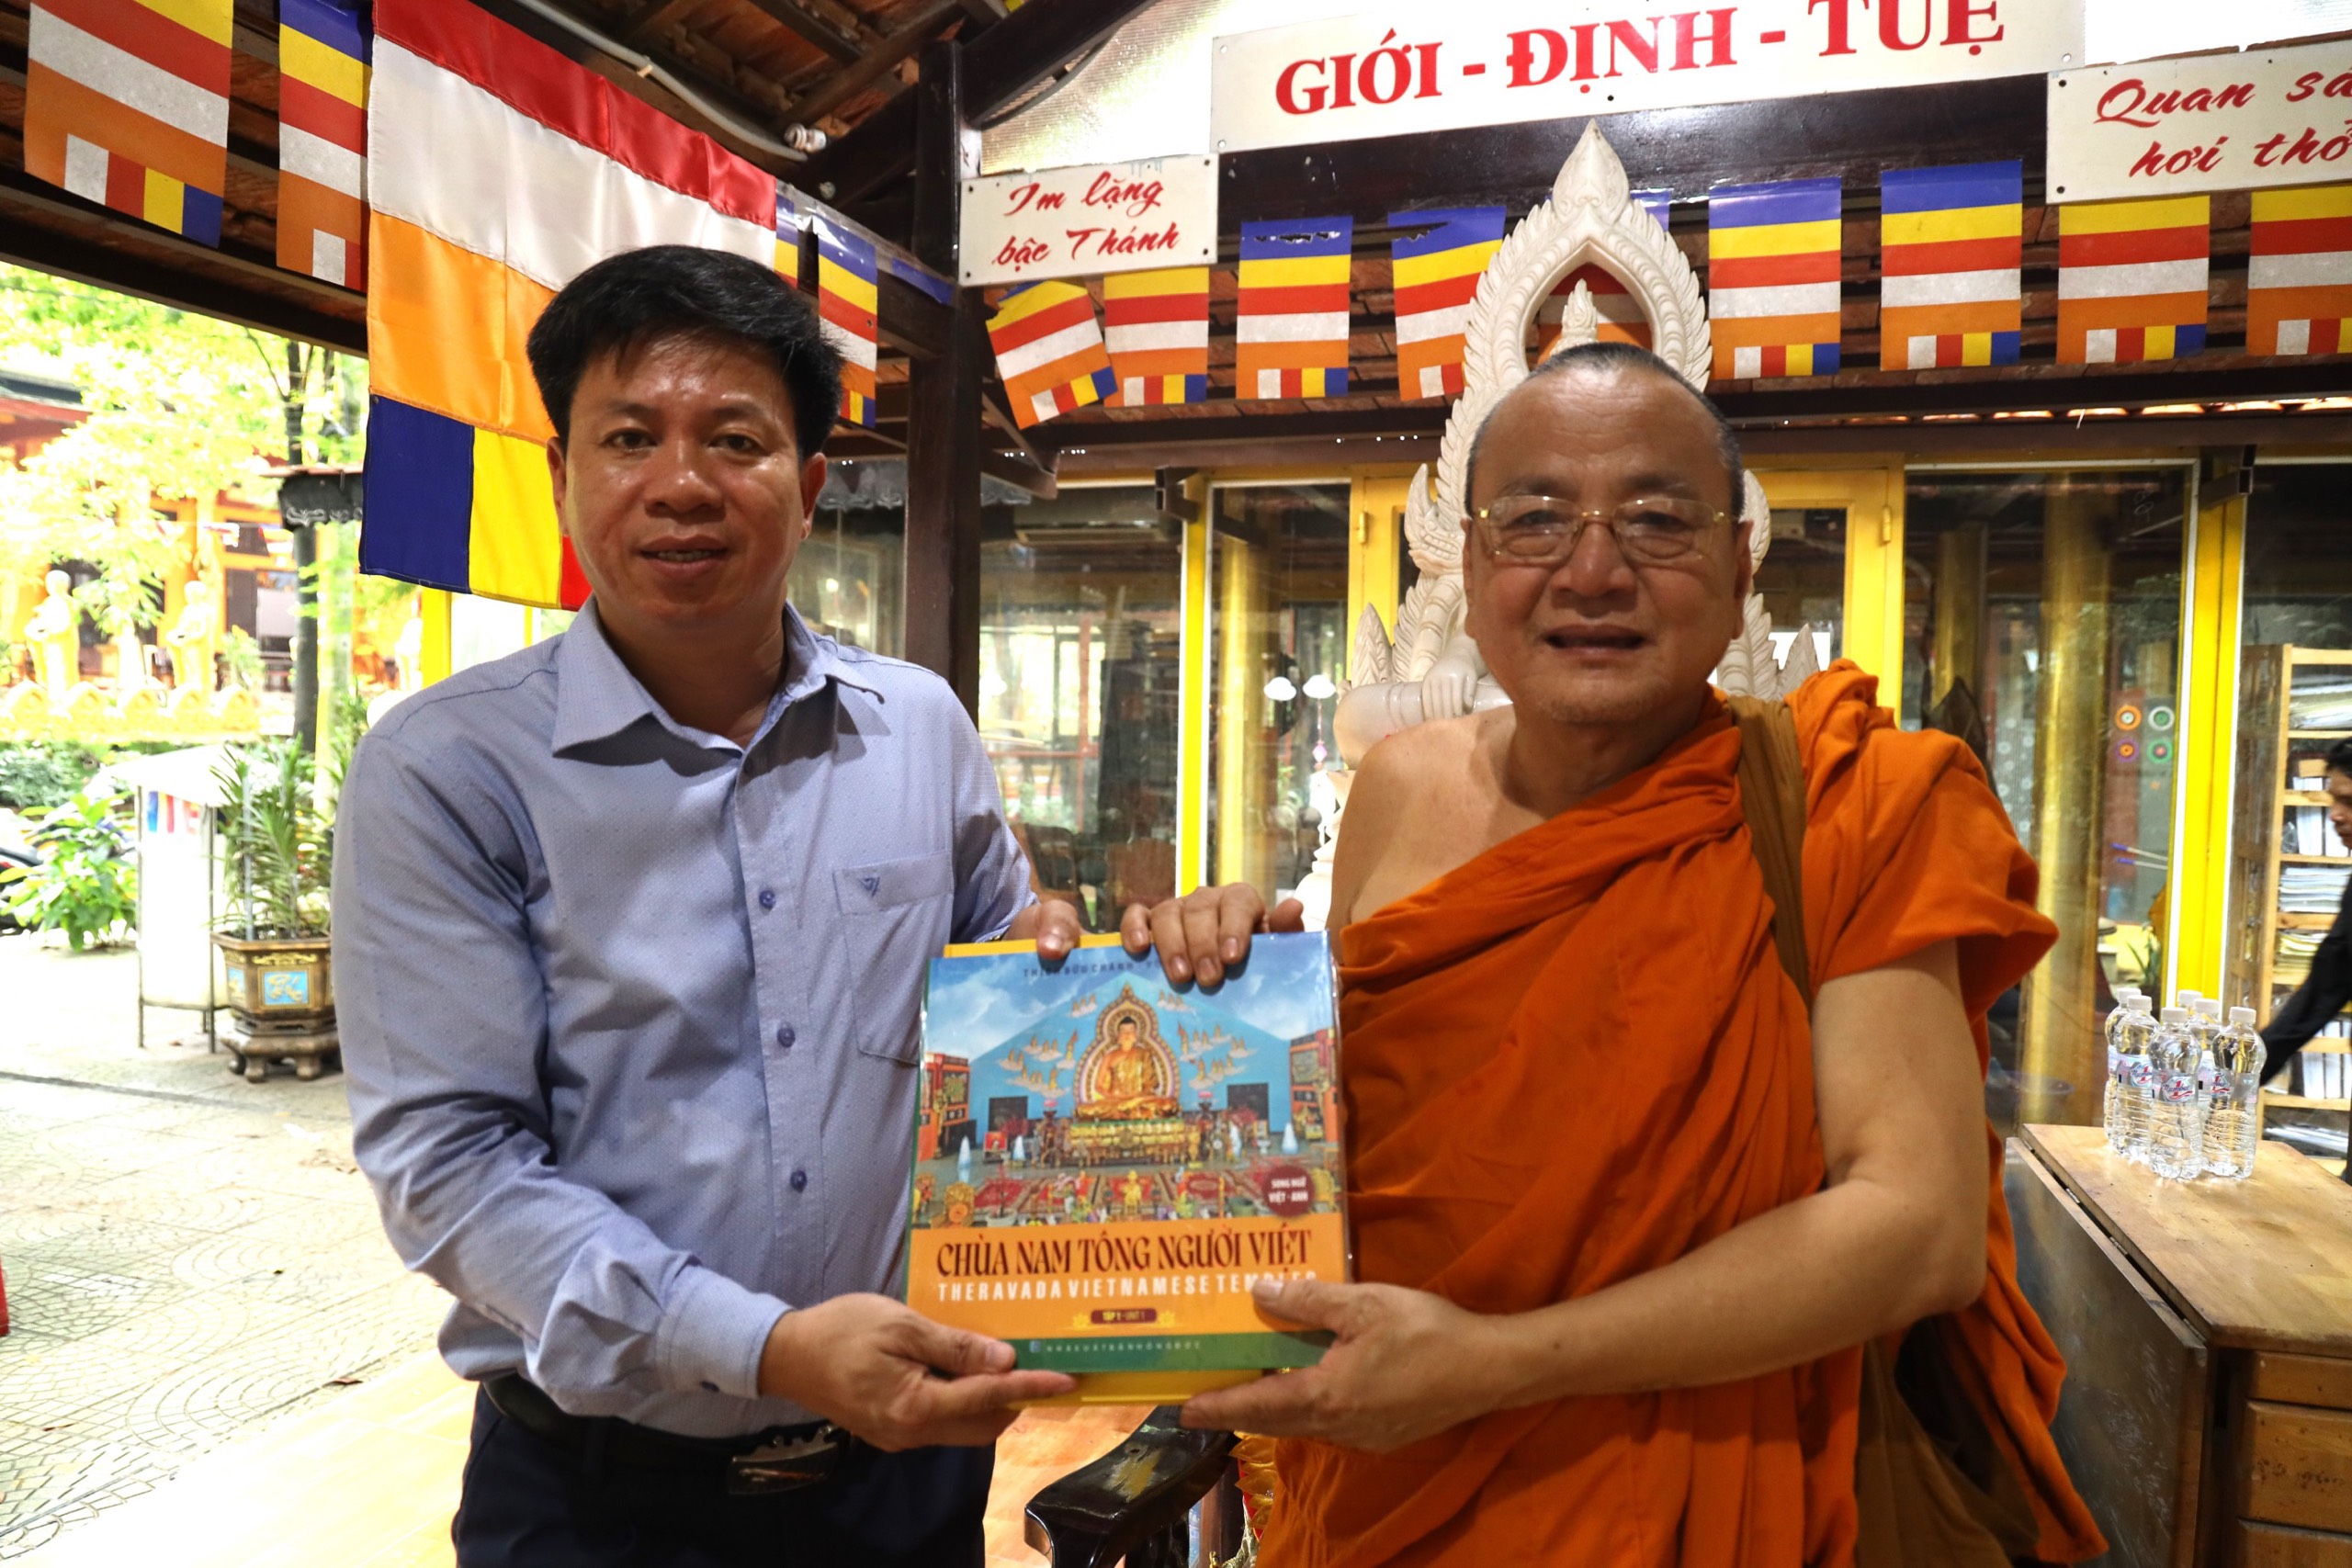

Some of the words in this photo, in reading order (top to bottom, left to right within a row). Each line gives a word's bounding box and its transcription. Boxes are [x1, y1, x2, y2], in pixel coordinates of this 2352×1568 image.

[1275, 28, 1443, 115] GIỚI
[1506, 7, 1738, 94] ĐỊNH
[2093, 78, 2256, 128] Quan
[2128, 136, 2230, 178] hơi
[2253, 119, 2352, 167] thở
[1003, 182, 1067, 218] Im
[1080, 171, 1164, 218] lặng
[991, 235, 1051, 272] bậc
[1066, 221, 1181, 261] Thánh
[937, 1234, 1010, 1278] CHÙA
[1017, 1240, 1071, 1275] NAM
[1078, 1230, 1150, 1273] TÔNG
[1158, 1224, 1241, 1270] NGƯỜI
[1248, 1222, 1312, 1273] VIỆT
[938, 1280, 1062, 1302] THERAVADA
[1069, 1272, 1210, 1298] VIETNAMESE
